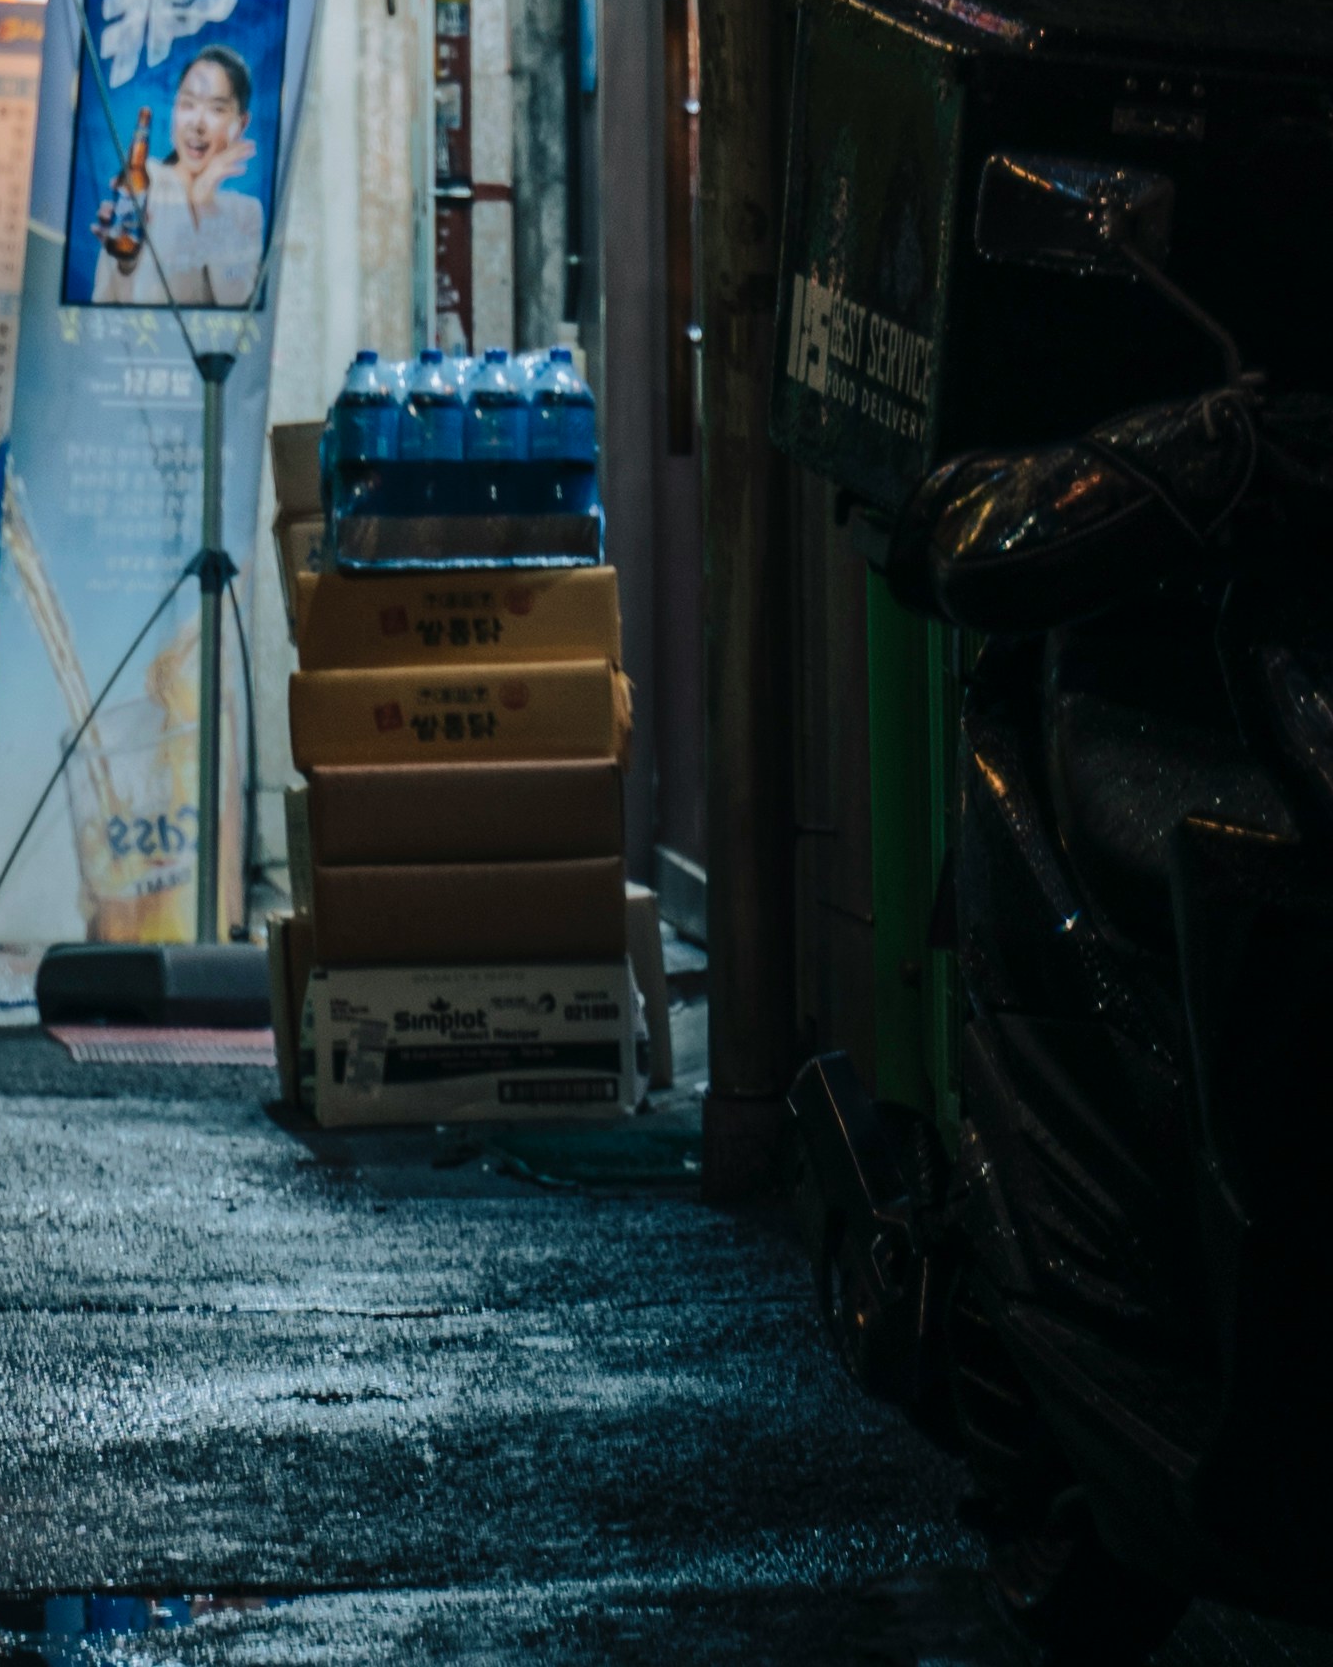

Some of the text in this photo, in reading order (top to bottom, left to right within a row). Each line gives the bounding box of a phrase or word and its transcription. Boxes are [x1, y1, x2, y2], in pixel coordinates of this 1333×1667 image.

[866, 311, 935, 406] SERVICE
[861, 386, 927, 444] DELIVERY
[393, 1009, 488, 1036] Simplot
